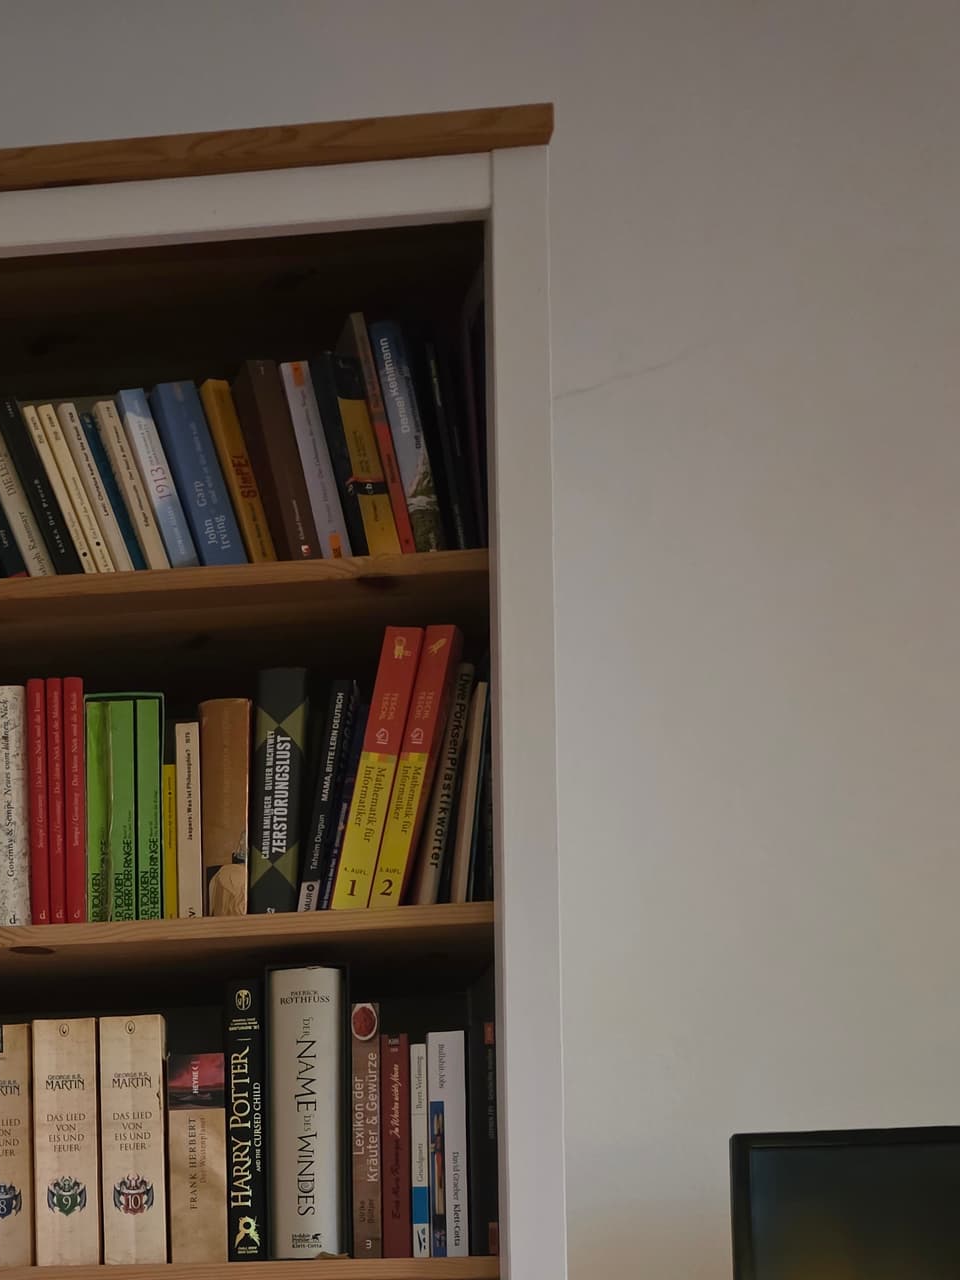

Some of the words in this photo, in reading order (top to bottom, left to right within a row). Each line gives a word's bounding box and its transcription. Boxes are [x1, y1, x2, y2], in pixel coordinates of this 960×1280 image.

[379, 337, 400, 396] Kehlmann
[395, 397, 411, 433] Daniel
[1, 476, 17, 496] DIE
[150, 466, 173, 500] 1913
[193, 480, 208, 508] Garp
[46, 511, 56, 526] Der
[204, 519, 218, 545] John
[214, 515, 231, 550] Irving
[53, 528, 66, 554] KAFKA
[331, 692, 344, 732] DEUTSCH
[328, 731, 339, 750] LERN
[325, 750, 336, 772] BITTE
[264, 767, 274, 790] OLIVER
[320, 773, 333, 801] MAMA,
[393, 765, 411, 820] Informatiker
[403, 765, 422, 819] Mathematik
[270, 734, 291, 853] ZERSTÖRUNGSLUST
[354, 766, 375, 826] Informatiker
[366, 767, 387, 826] Mathematik
[314, 814, 326, 843] Durgun
[363, 827, 374, 842] für
[400, 820, 412, 834] für
[122, 839, 132, 868] RINGE
[149, 838, 158, 866] RINGE
[114, 872, 123, 909] TOLKIEN
[123, 869, 132, 887] DER
[140, 871, 149, 908] TOLKIEN
[149, 867, 158, 886] DER
[346, 880, 356, 897] 1
[380, 879, 393, 896] 2
[124, 888, 133, 912] HERR
[150, 886, 159, 911] HERR
[45, 1078, 85, 1091] MARTIN
[112, 1076, 152, 1089] MARTIN
[230, 1045, 251, 1129] POTTER
[294, 1039, 317, 1112] NAME
[353, 1076, 364, 1100] der
[366, 1052, 379, 1113] Gewürze
[252, 1082, 261, 1110] CHILD
[112, 1111, 130, 1120] DAS
[132, 1111, 152, 1119] LIED
[122, 1122, 142, 1130] VON
[253, 1112, 261, 1147] CURSED
[353, 1103, 364, 1155] Lexikon
[367, 1115, 378, 1125] &
[115, 1132, 128, 1141] EIS
[129, 1131, 151, 1140] UND
[188, 1117, 196, 1169] HERBERT
[367, 1129, 379, 1182] Kräuter
[230, 1136, 252, 1208] HARRY
[297, 1132, 317, 1216] WINDES
[63, 1194, 71, 1208] 9
[127, 1194, 140, 1207] 10
[189, 1172, 198, 1209] FRANK
